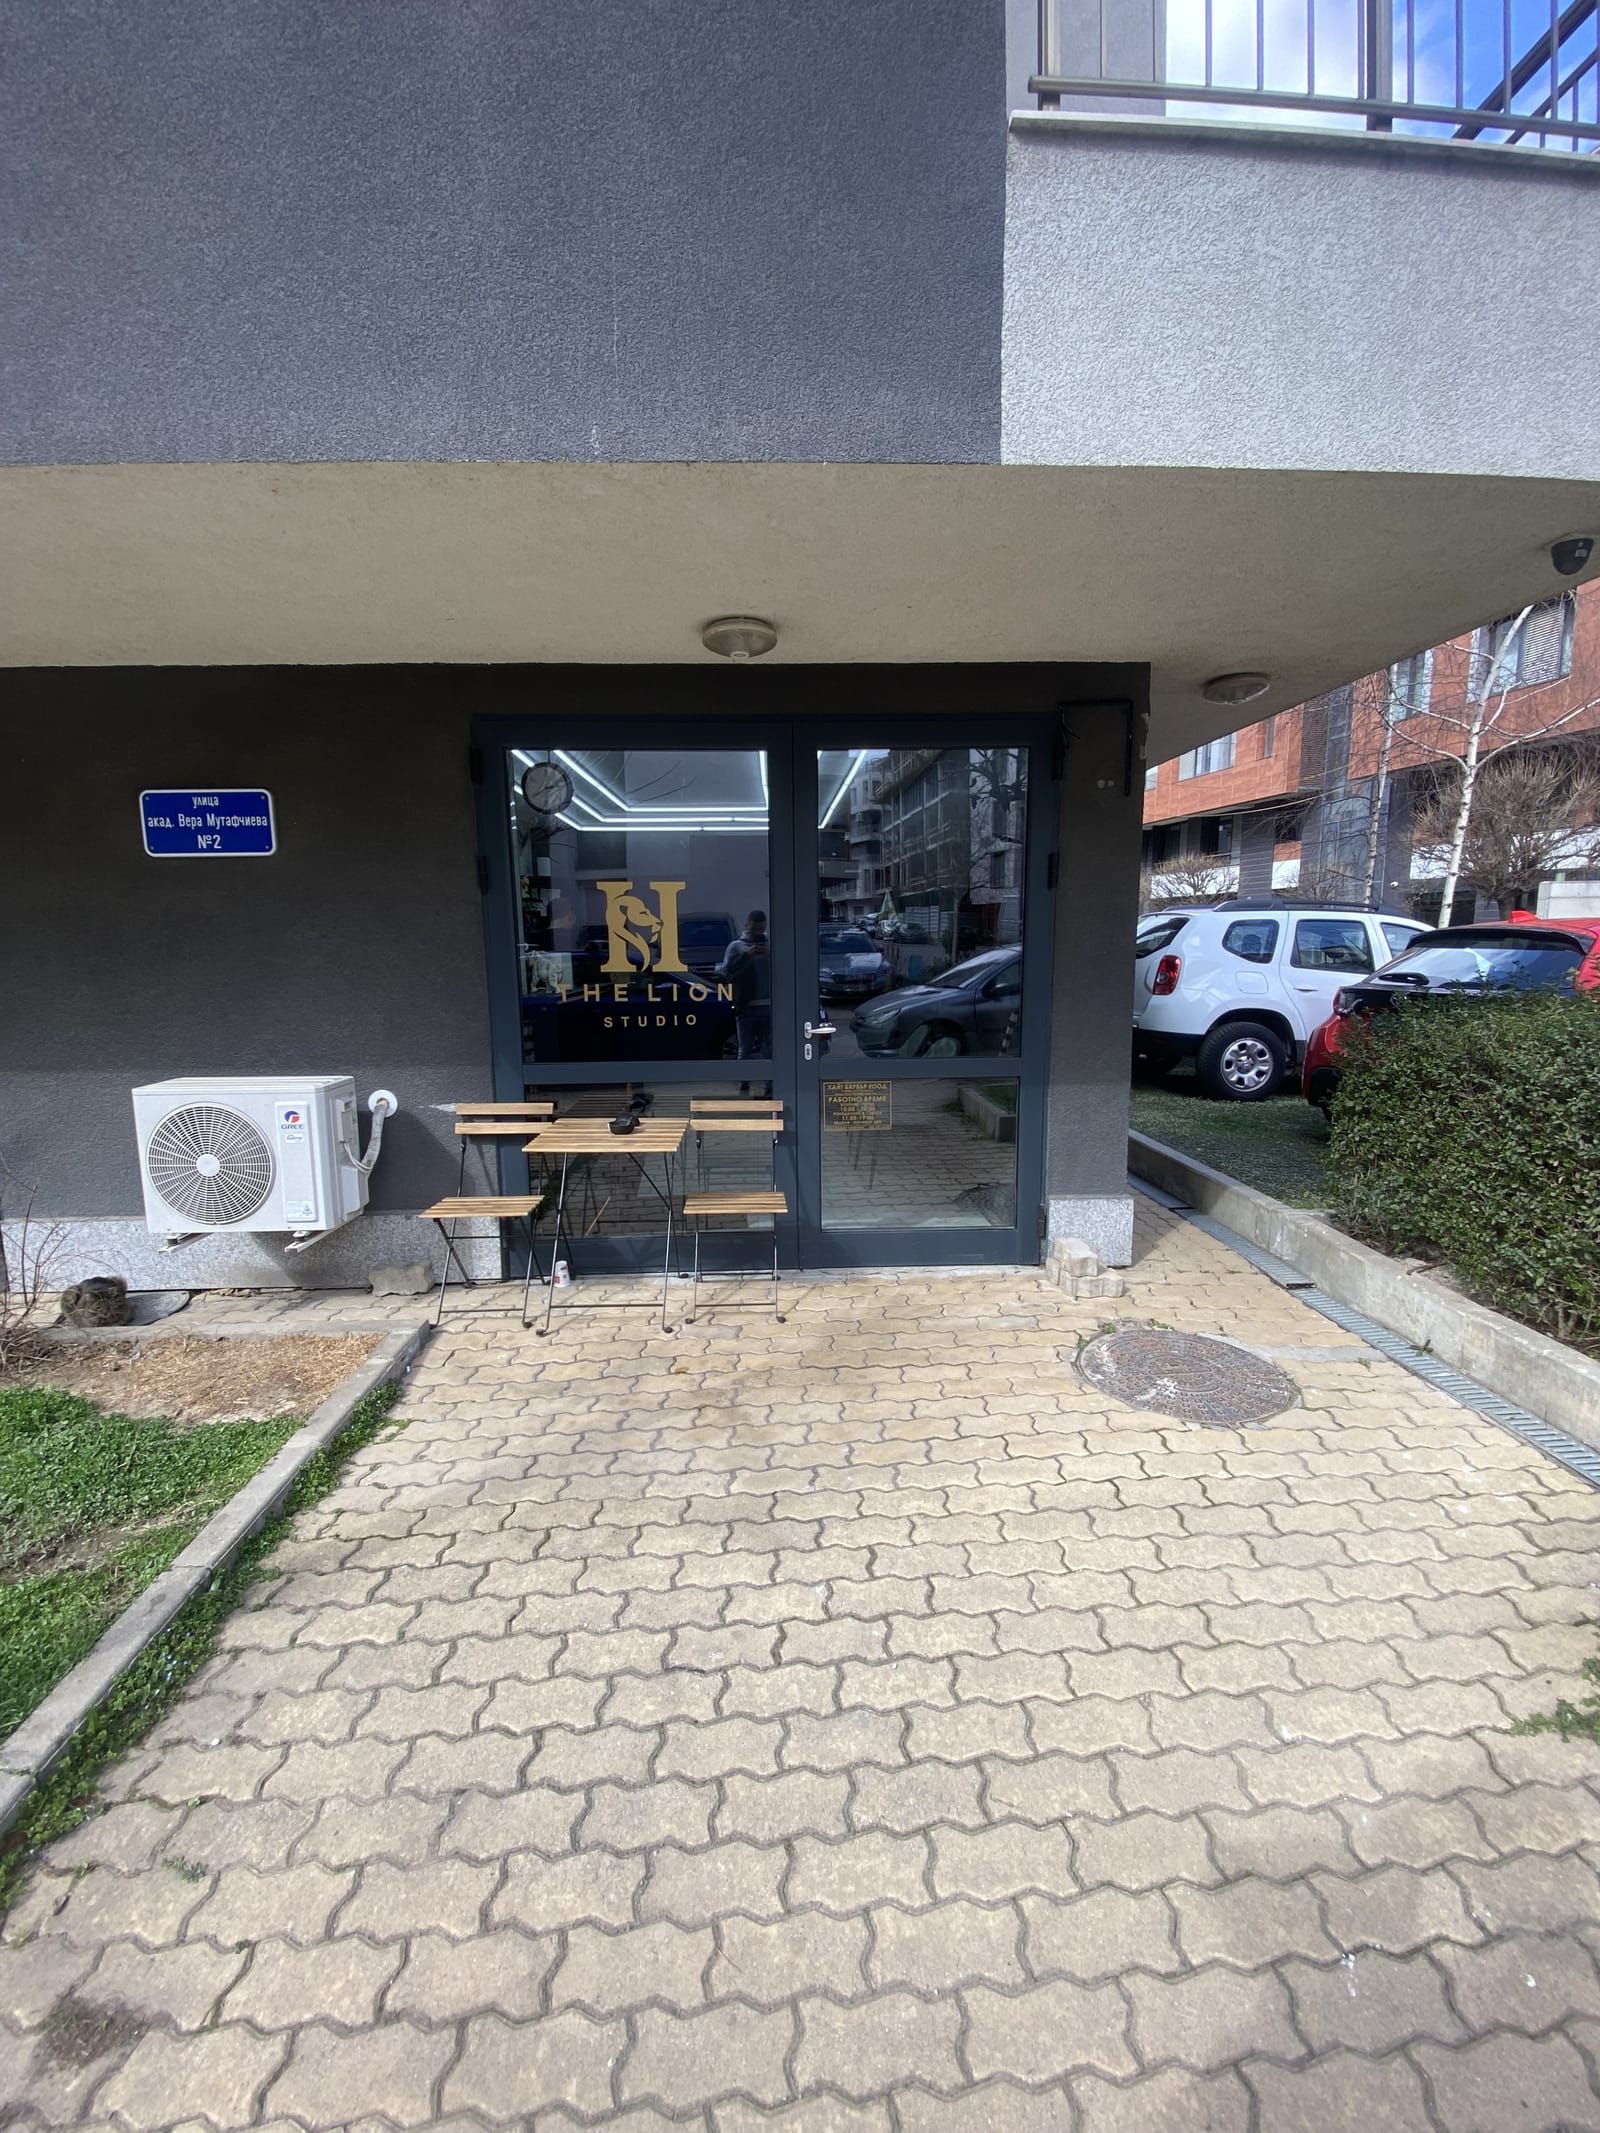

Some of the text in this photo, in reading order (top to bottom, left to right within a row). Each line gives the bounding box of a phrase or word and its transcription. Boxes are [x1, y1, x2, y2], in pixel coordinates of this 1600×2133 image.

[191, 796, 220, 809] улица
[147, 812, 268, 830] акад. Вера Мутафчиева
[559, 982, 734, 1002] THE LION
[603, 1014, 697, 1028] STUDIO
